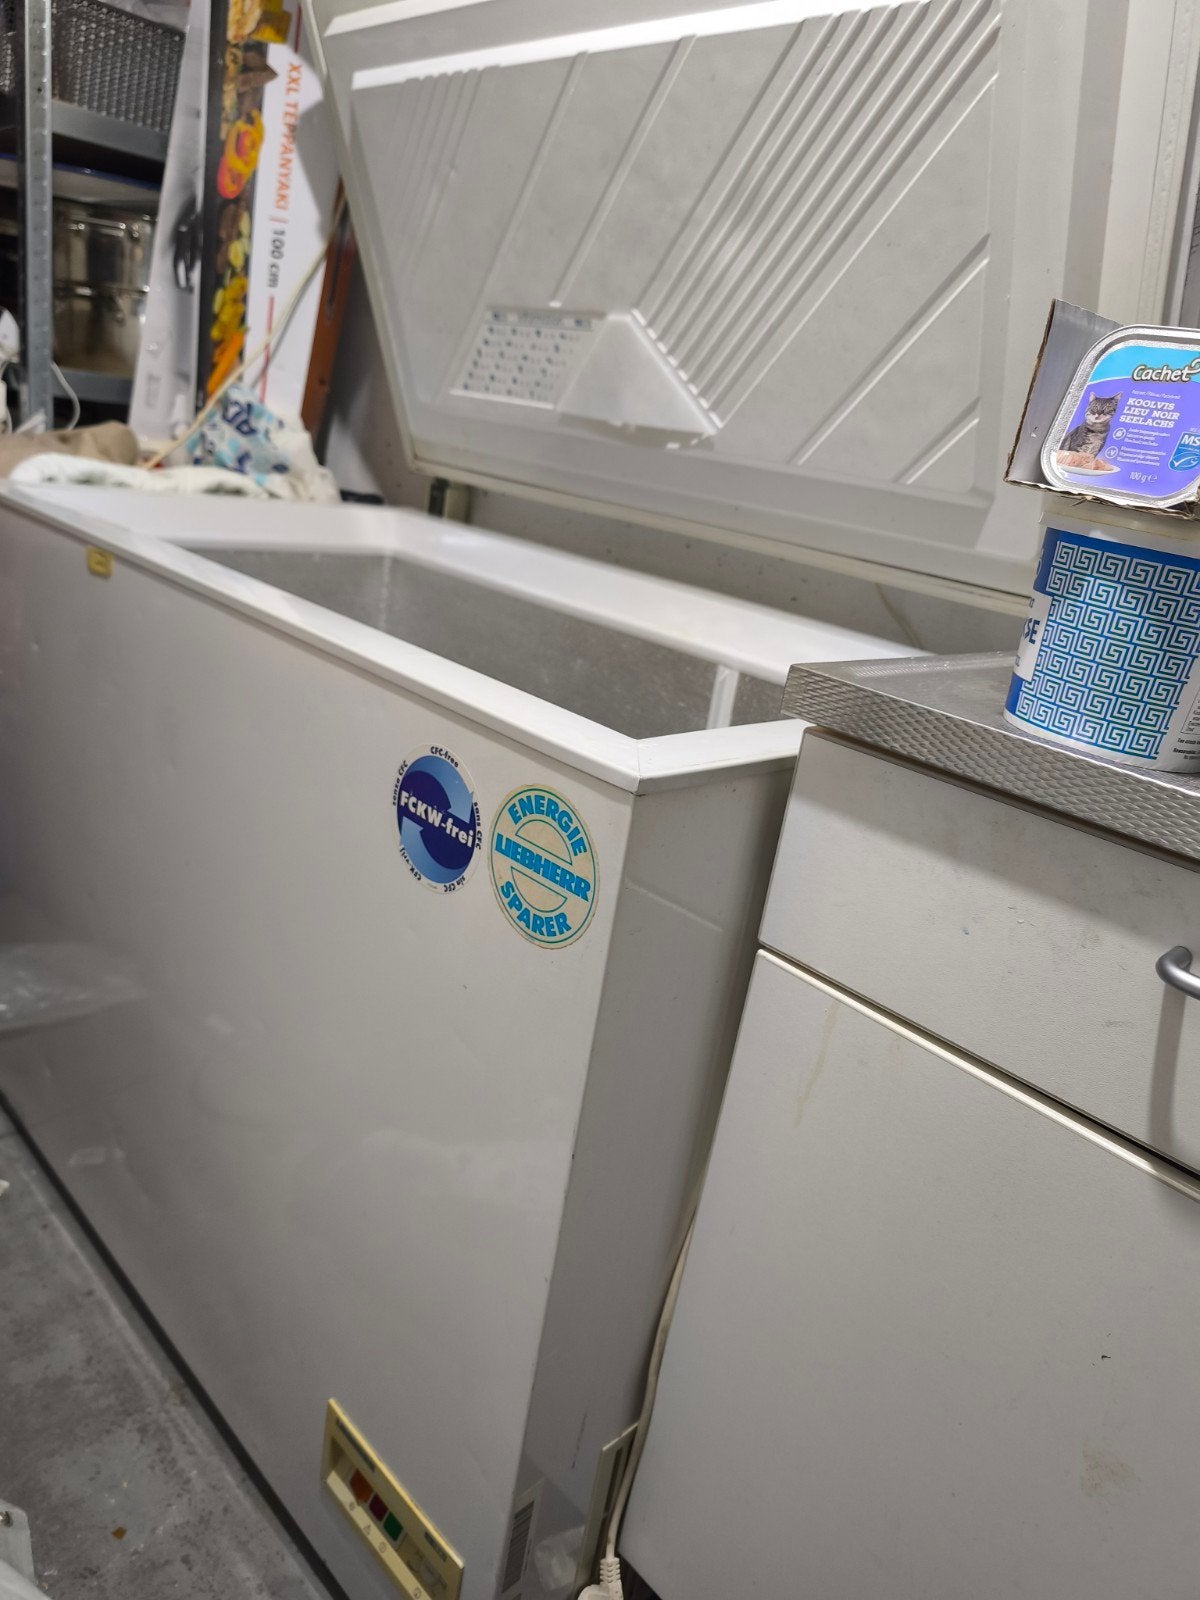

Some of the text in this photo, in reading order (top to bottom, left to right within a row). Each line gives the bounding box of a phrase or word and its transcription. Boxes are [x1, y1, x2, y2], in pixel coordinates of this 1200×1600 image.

[267, 63, 303, 289] XXL TEPPANYAKI 100 cm
[1132, 364, 1193, 382] Cachet
[1123, 406, 1180, 420] LIEU NOIR
[1127, 398, 1175, 410] KOOLVIS
[1119, 414, 1175, 428] SEELACHS
[1130, 471, 1142, 480] 100
[430, 745, 459, 768] CFC-free
[398, 760, 409, 776] CFC
[399, 790, 474, 848] FCKW-frei
[473, 801, 481, 827] sans
[507, 794, 588, 858] ENERGIE
[494, 832, 592, 902] LIEBHERR
[443, 883, 456, 893] CFC
[456, 875, 466, 886] sin
[500, 880, 572, 937] SPARER
